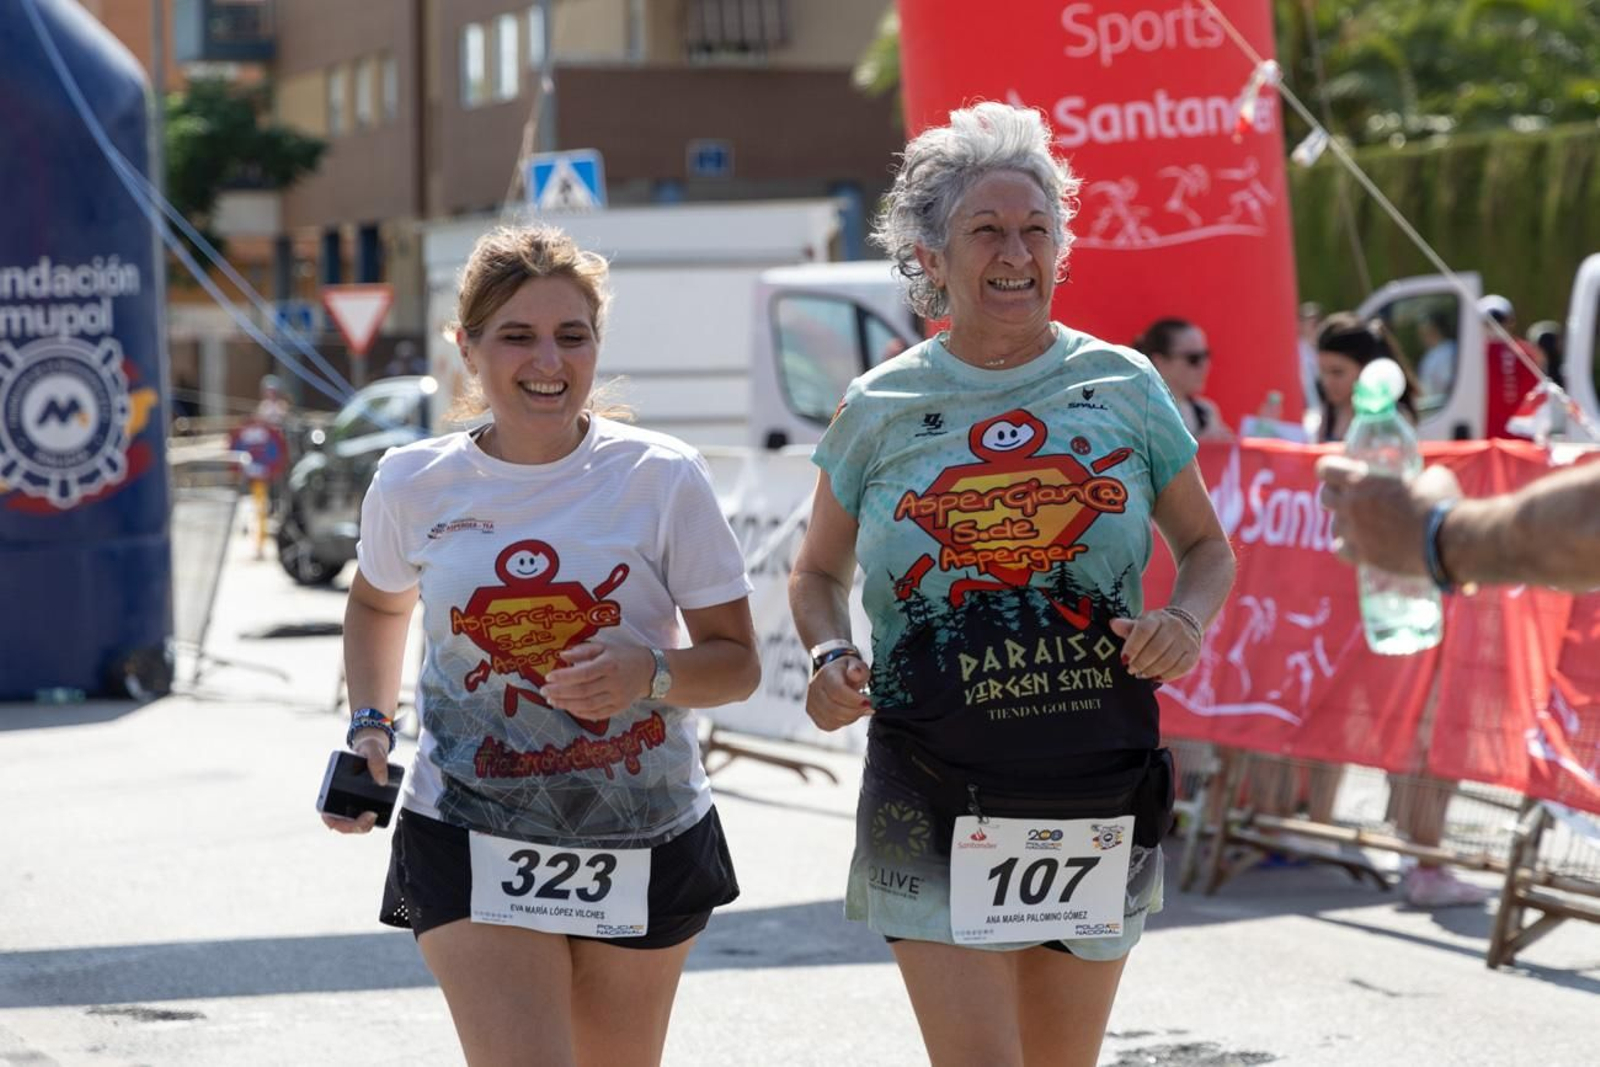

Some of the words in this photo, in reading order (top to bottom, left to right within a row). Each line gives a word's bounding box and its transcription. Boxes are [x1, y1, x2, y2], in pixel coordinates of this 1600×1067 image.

[1061, 0, 1225, 67] Sports
[939, 543, 1089, 576] Asperger
[958, 632, 1116, 682] PARAISO
[965, 672, 1049, 705] VIRGEN
[1057, 667, 1113, 692] EXTRA
[987, 706, 1040, 720] TIENDA
[1043, 698, 1102, 715] GOURMET
[501, 849, 617, 902] 323
[988, 856, 1101, 906] 107
[510, 904, 524, 912] EVA
[525, 904, 548, 915] MARÍA
[550, 905, 573, 917] LÓPEZ
[575, 909, 605, 920] VILCHES
[986, 915, 1000, 924] ANA
[1002, 912, 1025, 923] MARÍA
[1026, 911, 1062, 923] PALOMINO
[1063, 910, 1088, 921] GÓMEZ
